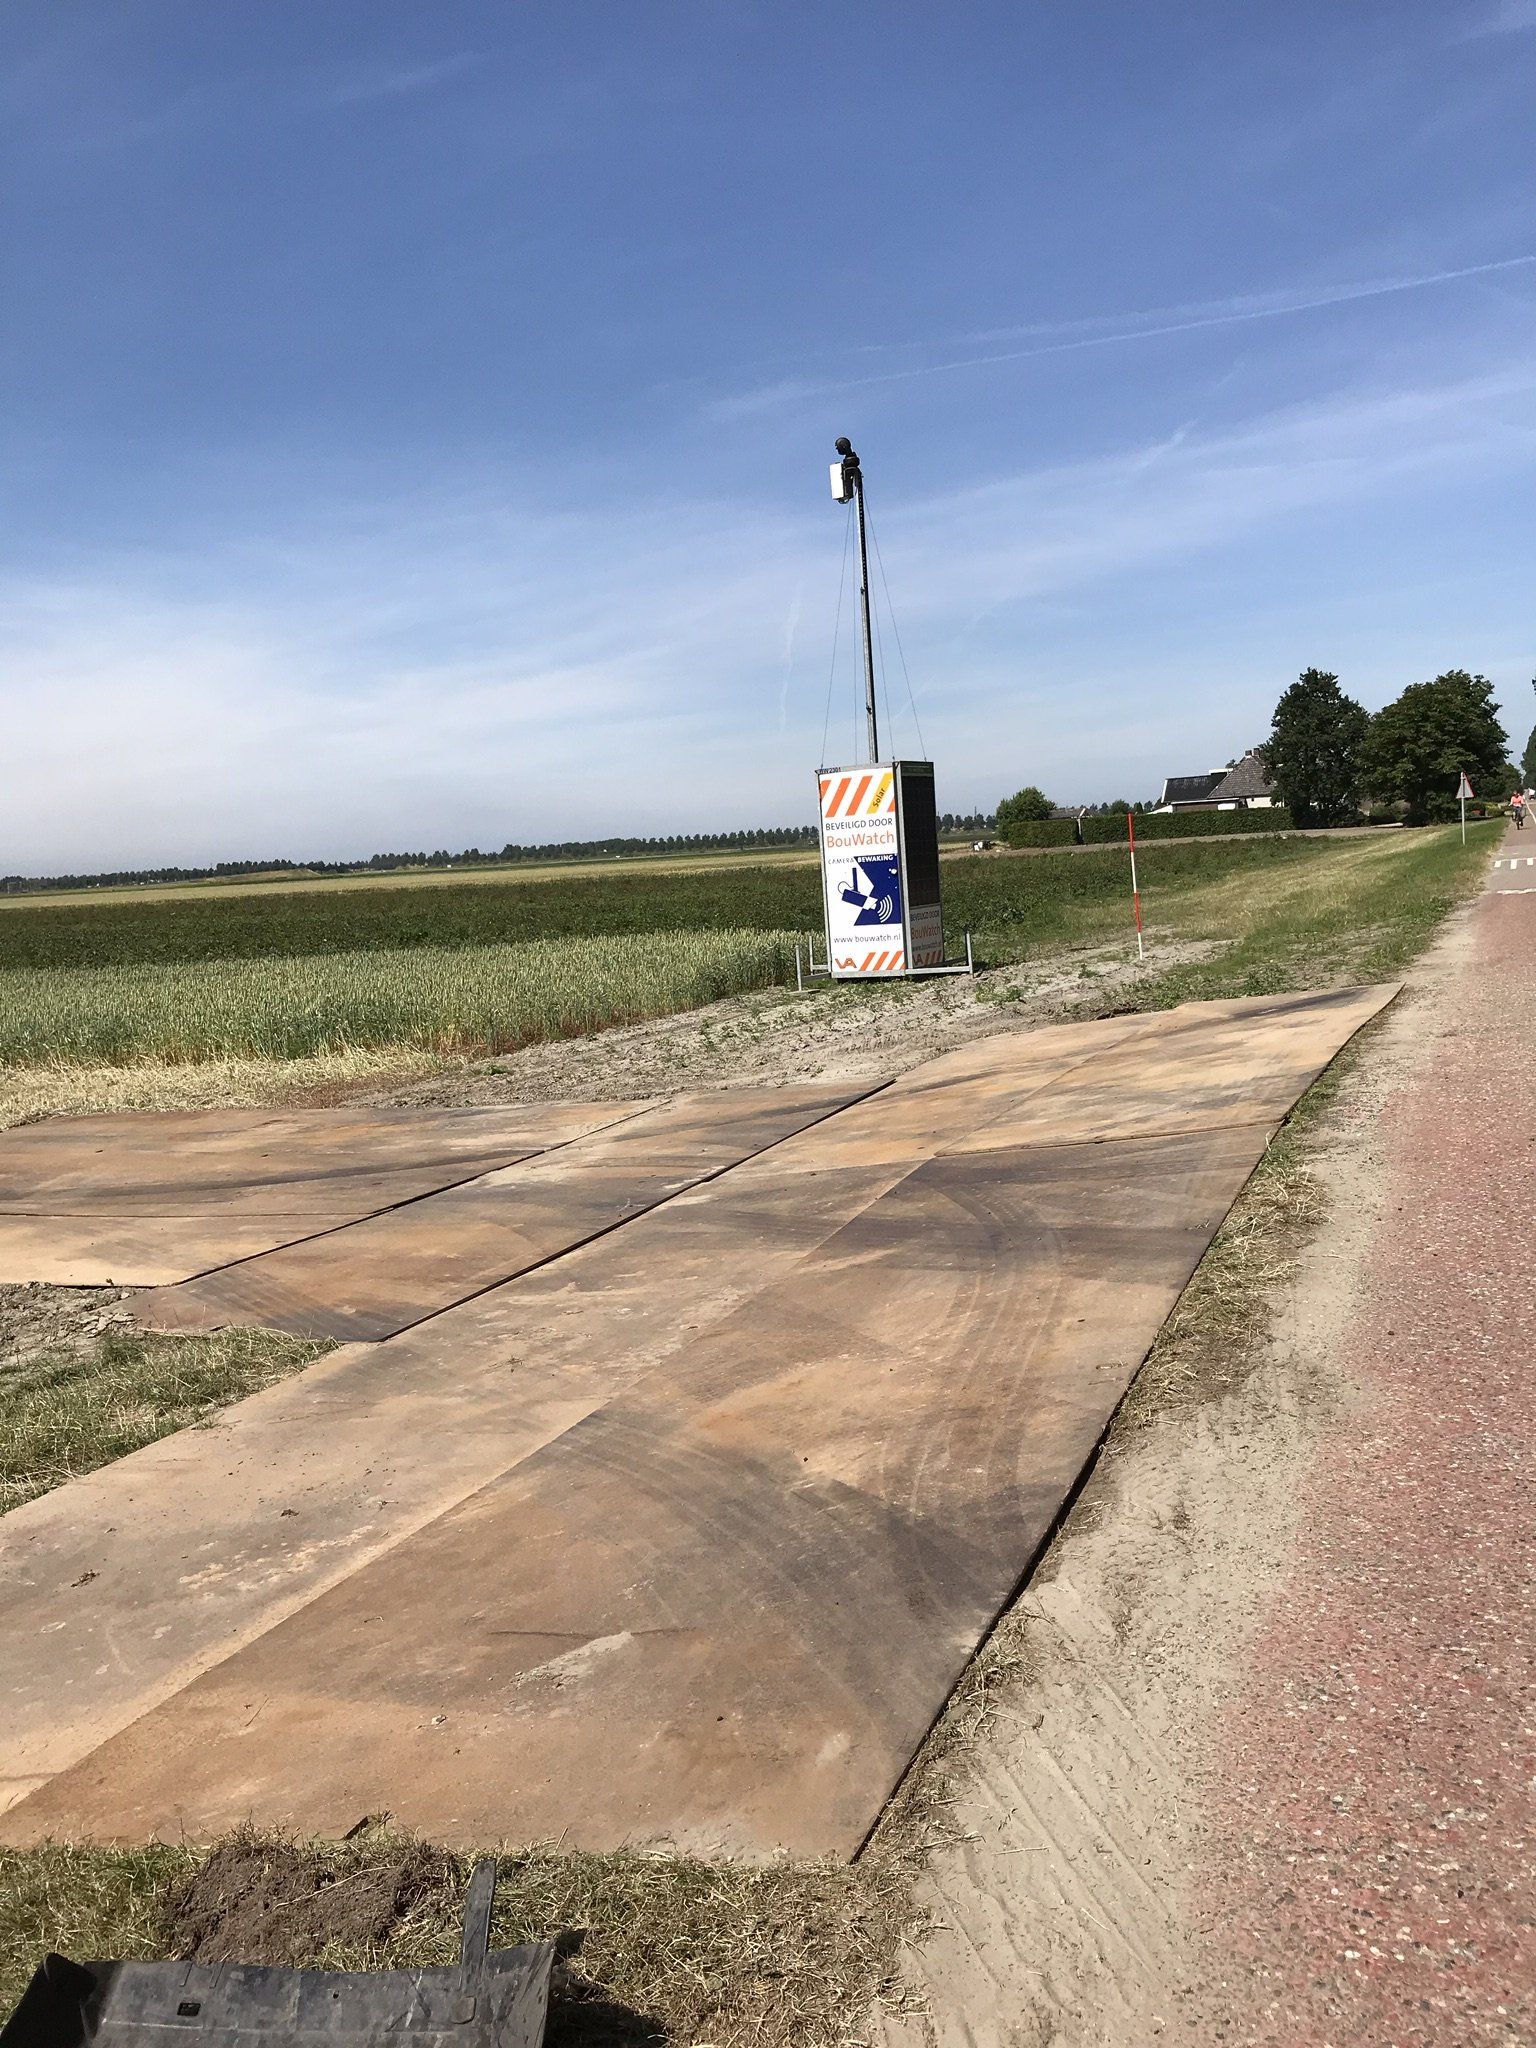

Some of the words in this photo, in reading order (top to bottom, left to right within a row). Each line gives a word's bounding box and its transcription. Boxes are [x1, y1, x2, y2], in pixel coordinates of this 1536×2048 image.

[873, 788, 885, 808] Solar
[825, 820, 867, 831] BEVEILIGD
[868, 818, 893, 827] DOOR
[826, 830, 895, 848] BouWatch
[828, 857, 855, 865] CAMERA
[857, 854, 894, 863] BEWAKING
[833, 934, 901, 943] www.bouwatch.nl
